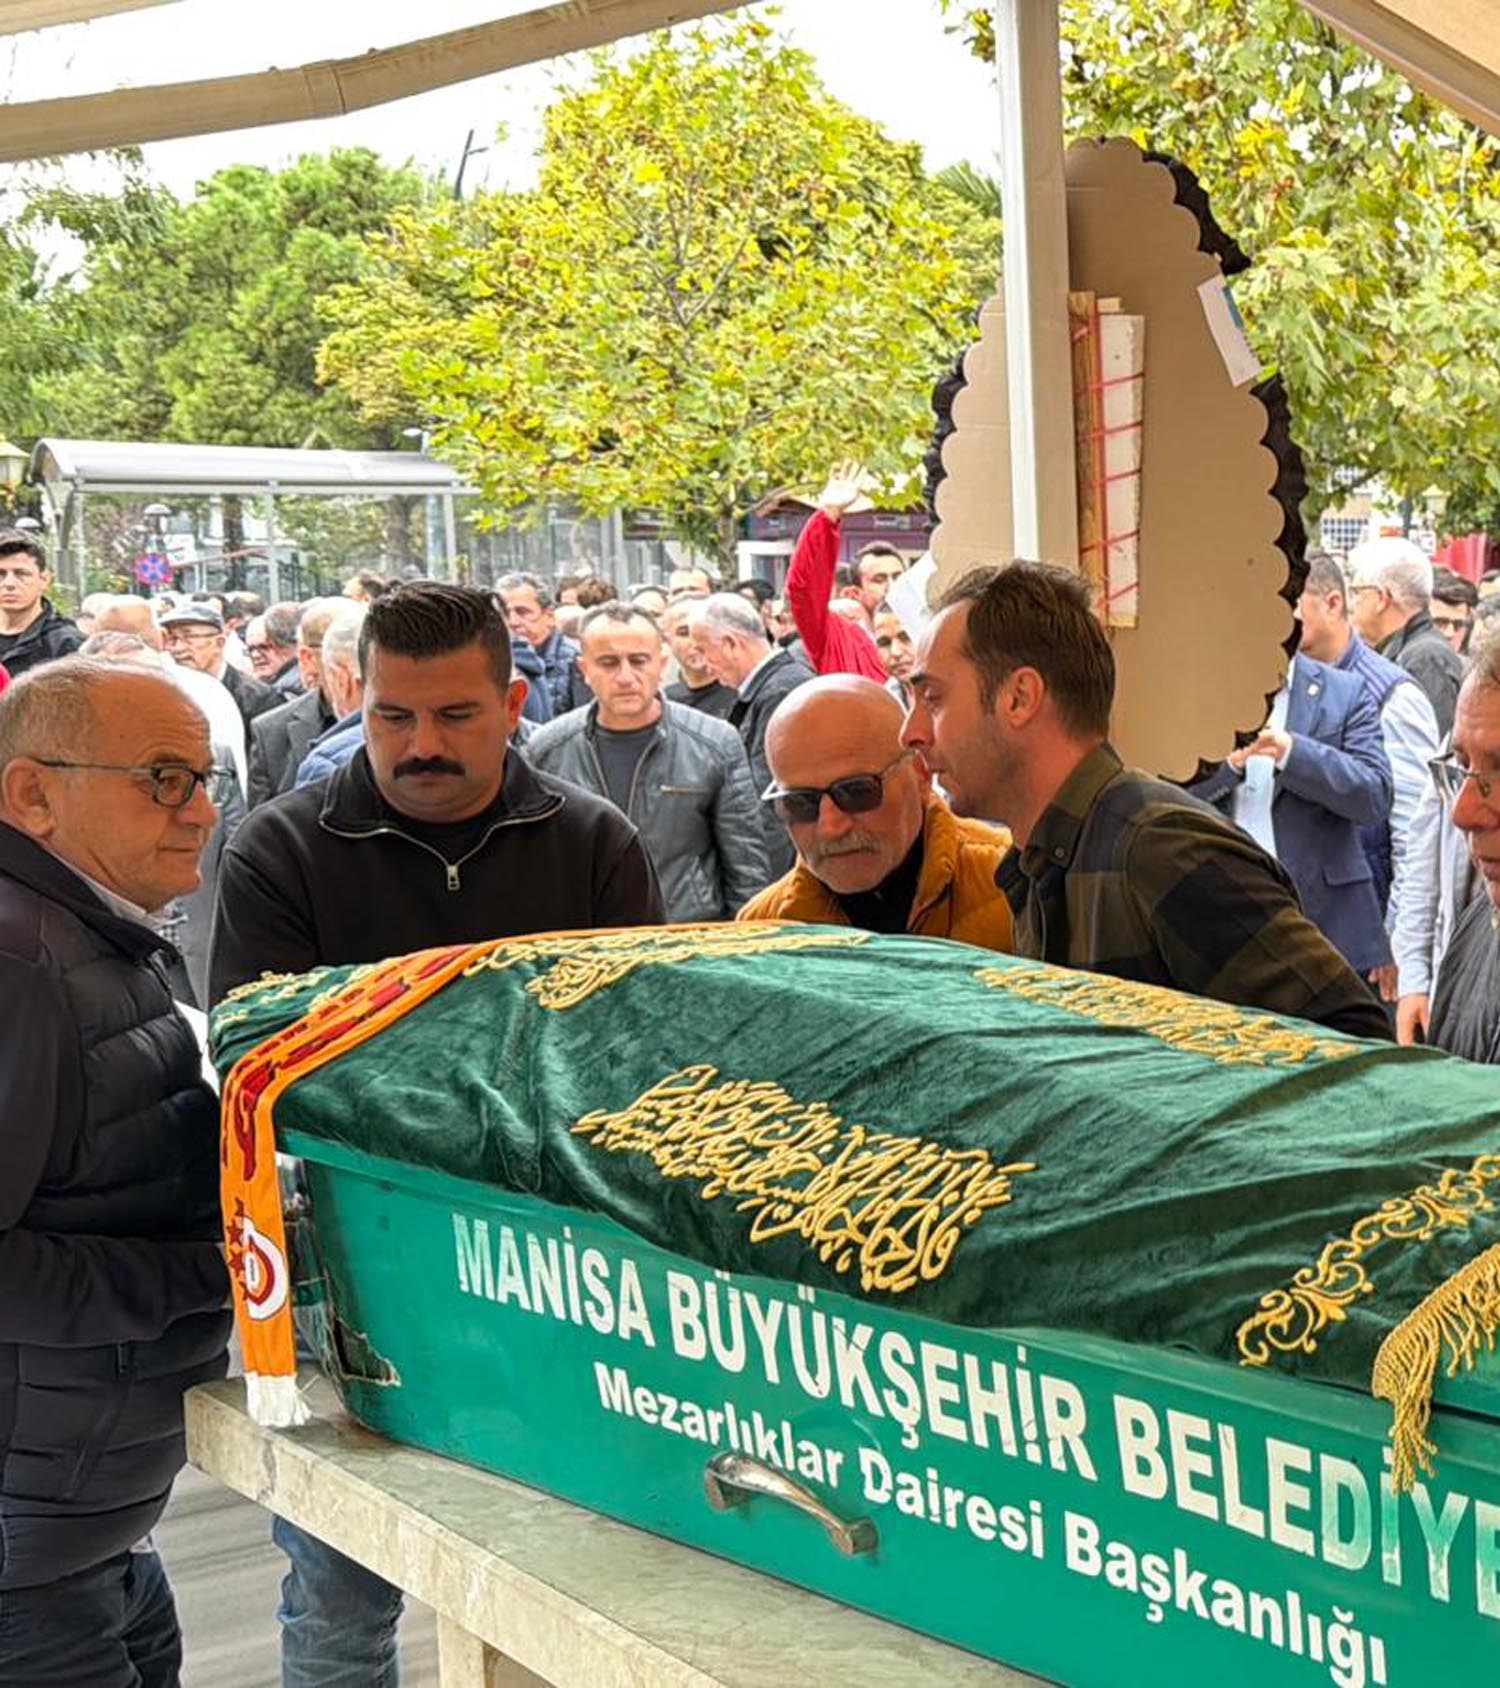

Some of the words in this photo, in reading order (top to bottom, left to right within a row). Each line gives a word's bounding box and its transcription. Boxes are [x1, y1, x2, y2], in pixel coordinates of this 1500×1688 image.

[452, 1212, 656, 1349] MANİSA
[666, 1267, 1098, 1483] BÜYÜKŞEHİR
[593, 1361, 844, 1489] Mezarlıklar
[858, 1446, 1044, 1560] Dairesi
[1063, 1509, 1388, 1688] Başkanlığı
